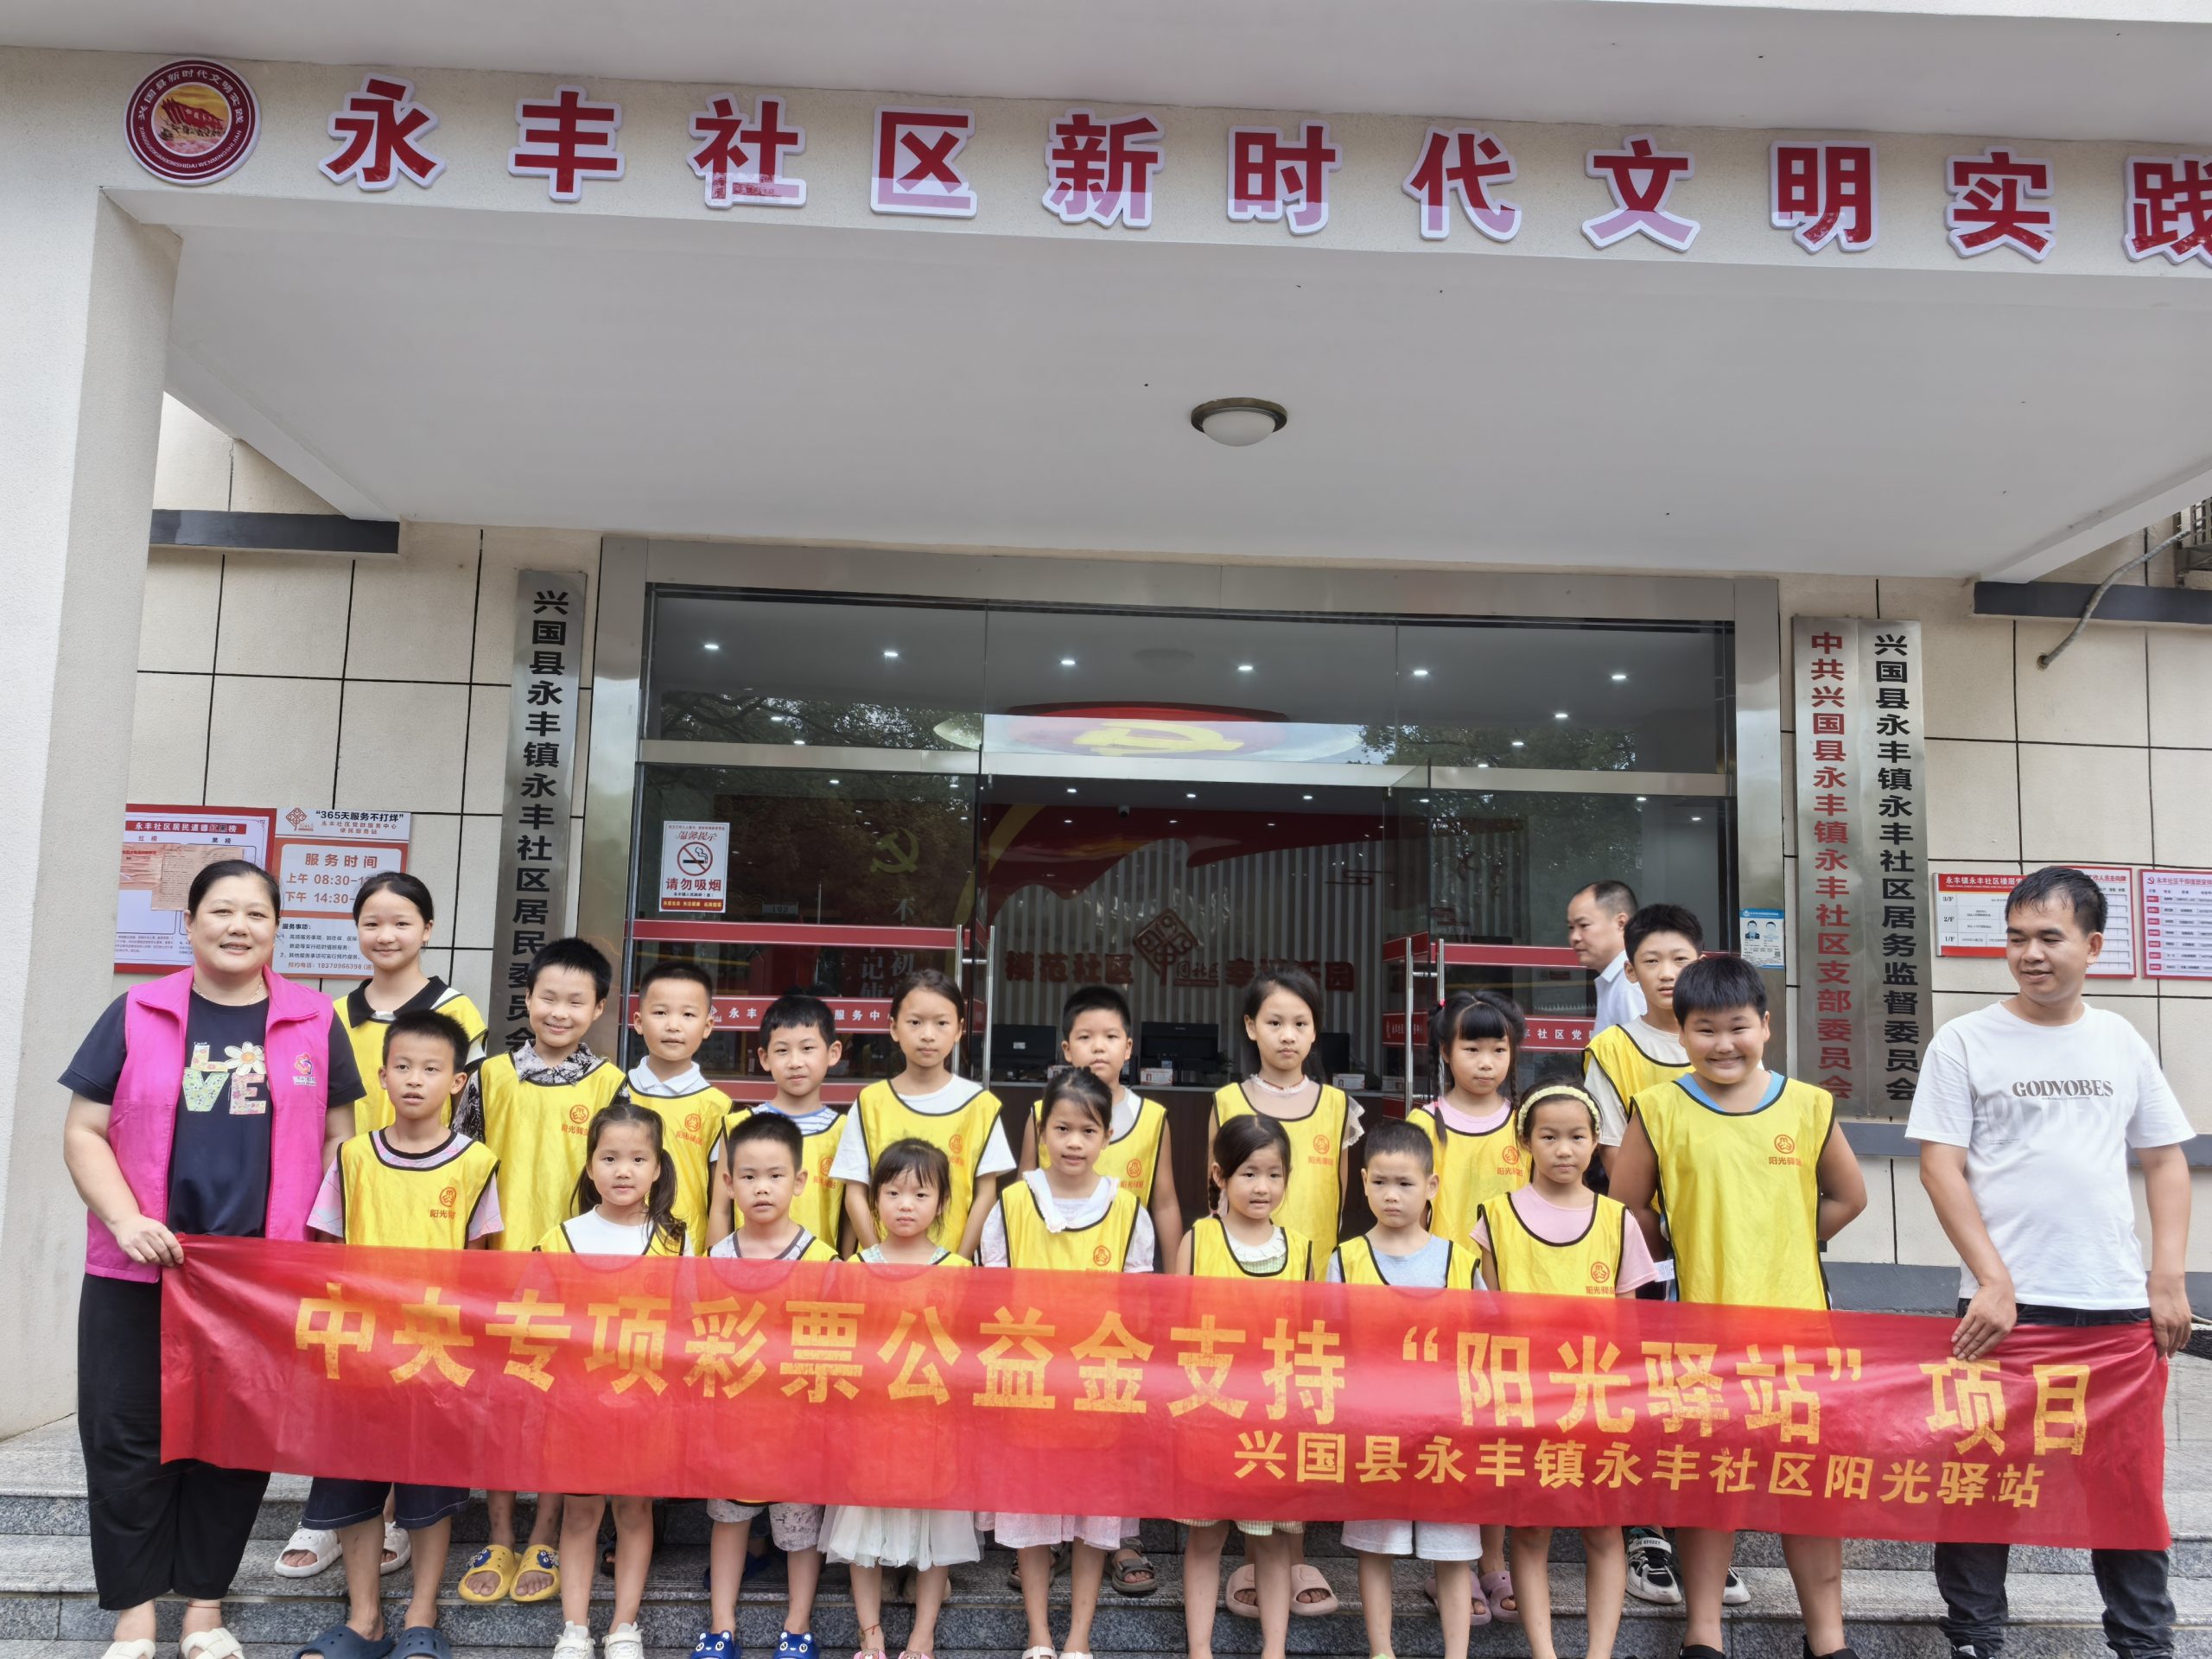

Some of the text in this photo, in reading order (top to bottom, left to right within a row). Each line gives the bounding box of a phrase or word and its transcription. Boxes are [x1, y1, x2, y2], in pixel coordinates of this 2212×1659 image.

[328, 76, 2212, 260] 永丰社区新时代文明实践
[316, 810, 404, 822] “365天服务不打烊”
[305, 854, 378, 868] 服务时间
[1811, 632, 1852, 1099] 中共兴国县永丰镇永丰社区支部委员会
[1875, 634, 1919, 1101] 兴国县永丰镇永丰社区居务监督委员会
[286, 873, 308, 884] 上午
[666, 878, 721, 891] 请勿吸烟
[285, 892, 307, 902] 下午
[2012, 1079, 2113, 1097] GODVOBES
[1234, 1430, 2044, 1508] 兴国县永丰镇永丰社区阳光驿站
